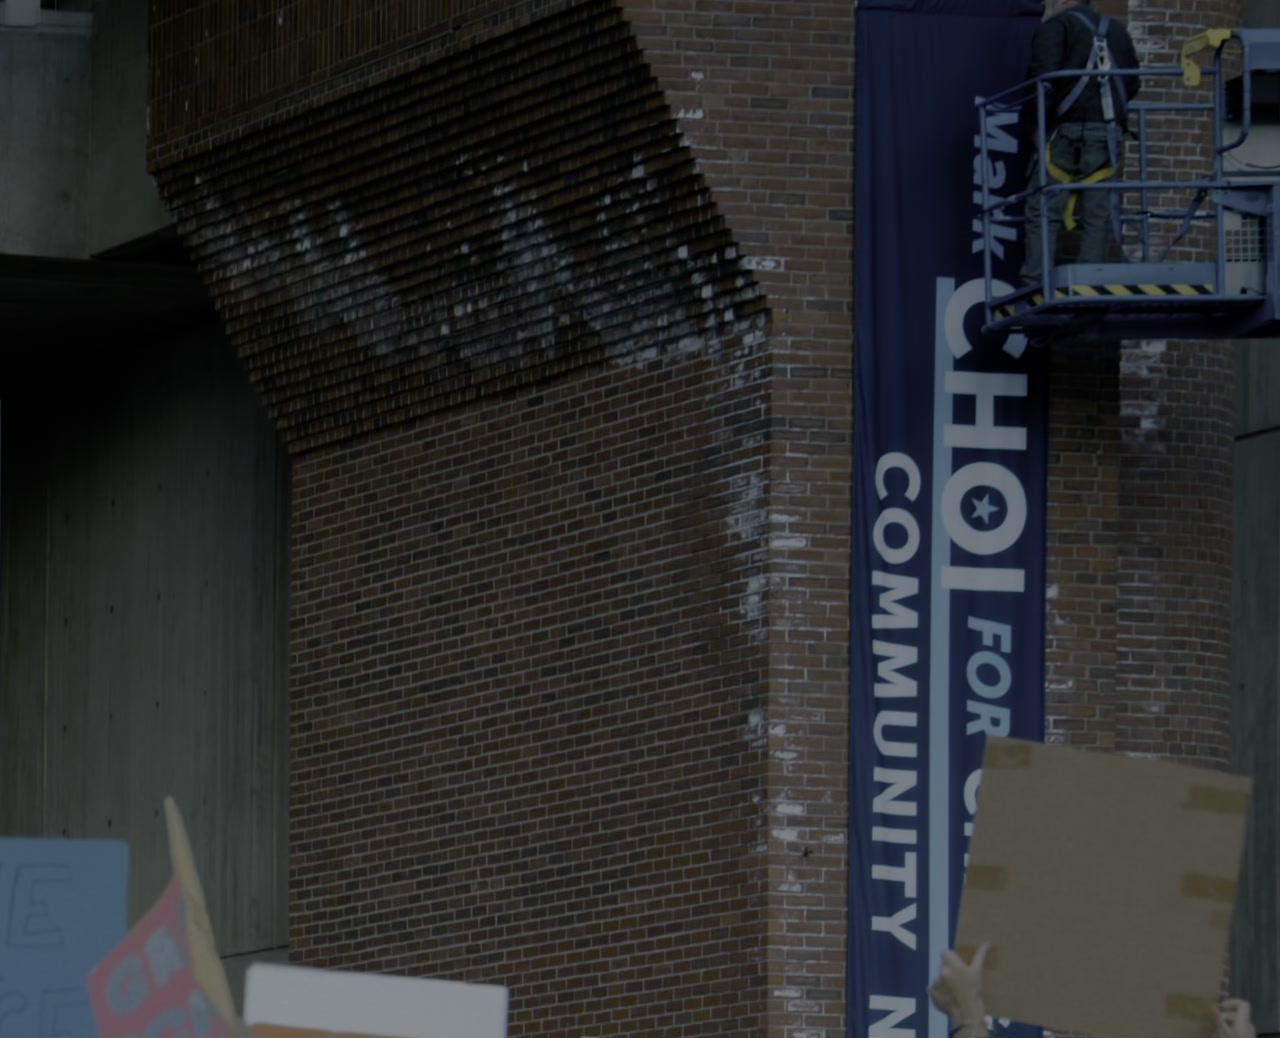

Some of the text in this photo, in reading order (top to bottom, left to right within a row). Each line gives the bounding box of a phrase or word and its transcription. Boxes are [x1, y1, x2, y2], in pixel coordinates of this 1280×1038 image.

[971, 95, 1021, 261] Mark
[940, 277, 1029, 593] CHOI
[871, 451, 922, 951] COMMUNITY
[964, 615, 1013, 738] FOR
